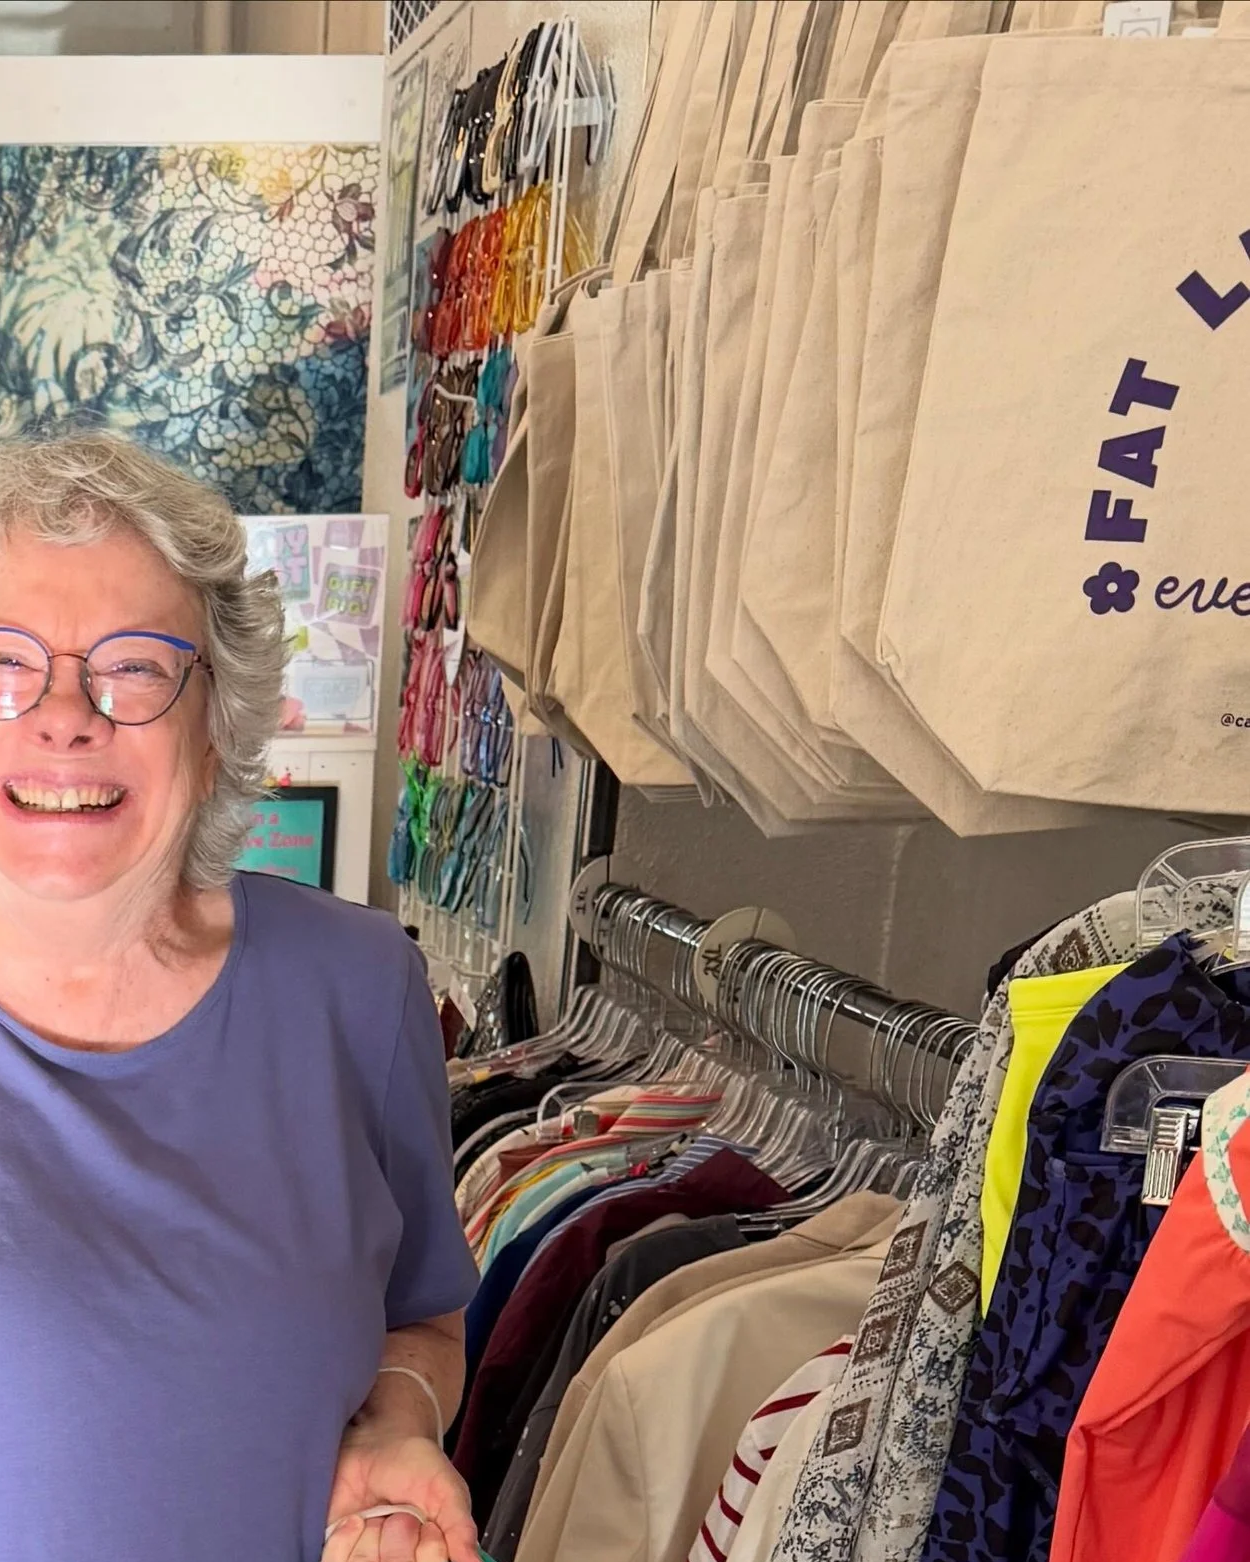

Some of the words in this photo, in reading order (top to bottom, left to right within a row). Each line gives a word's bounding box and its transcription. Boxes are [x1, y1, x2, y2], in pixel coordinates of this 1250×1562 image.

[1084, 357, 1180, 543] FAT
[575, 886, 589, 915] 1XL
[701, 943, 724, 982] 2XL
